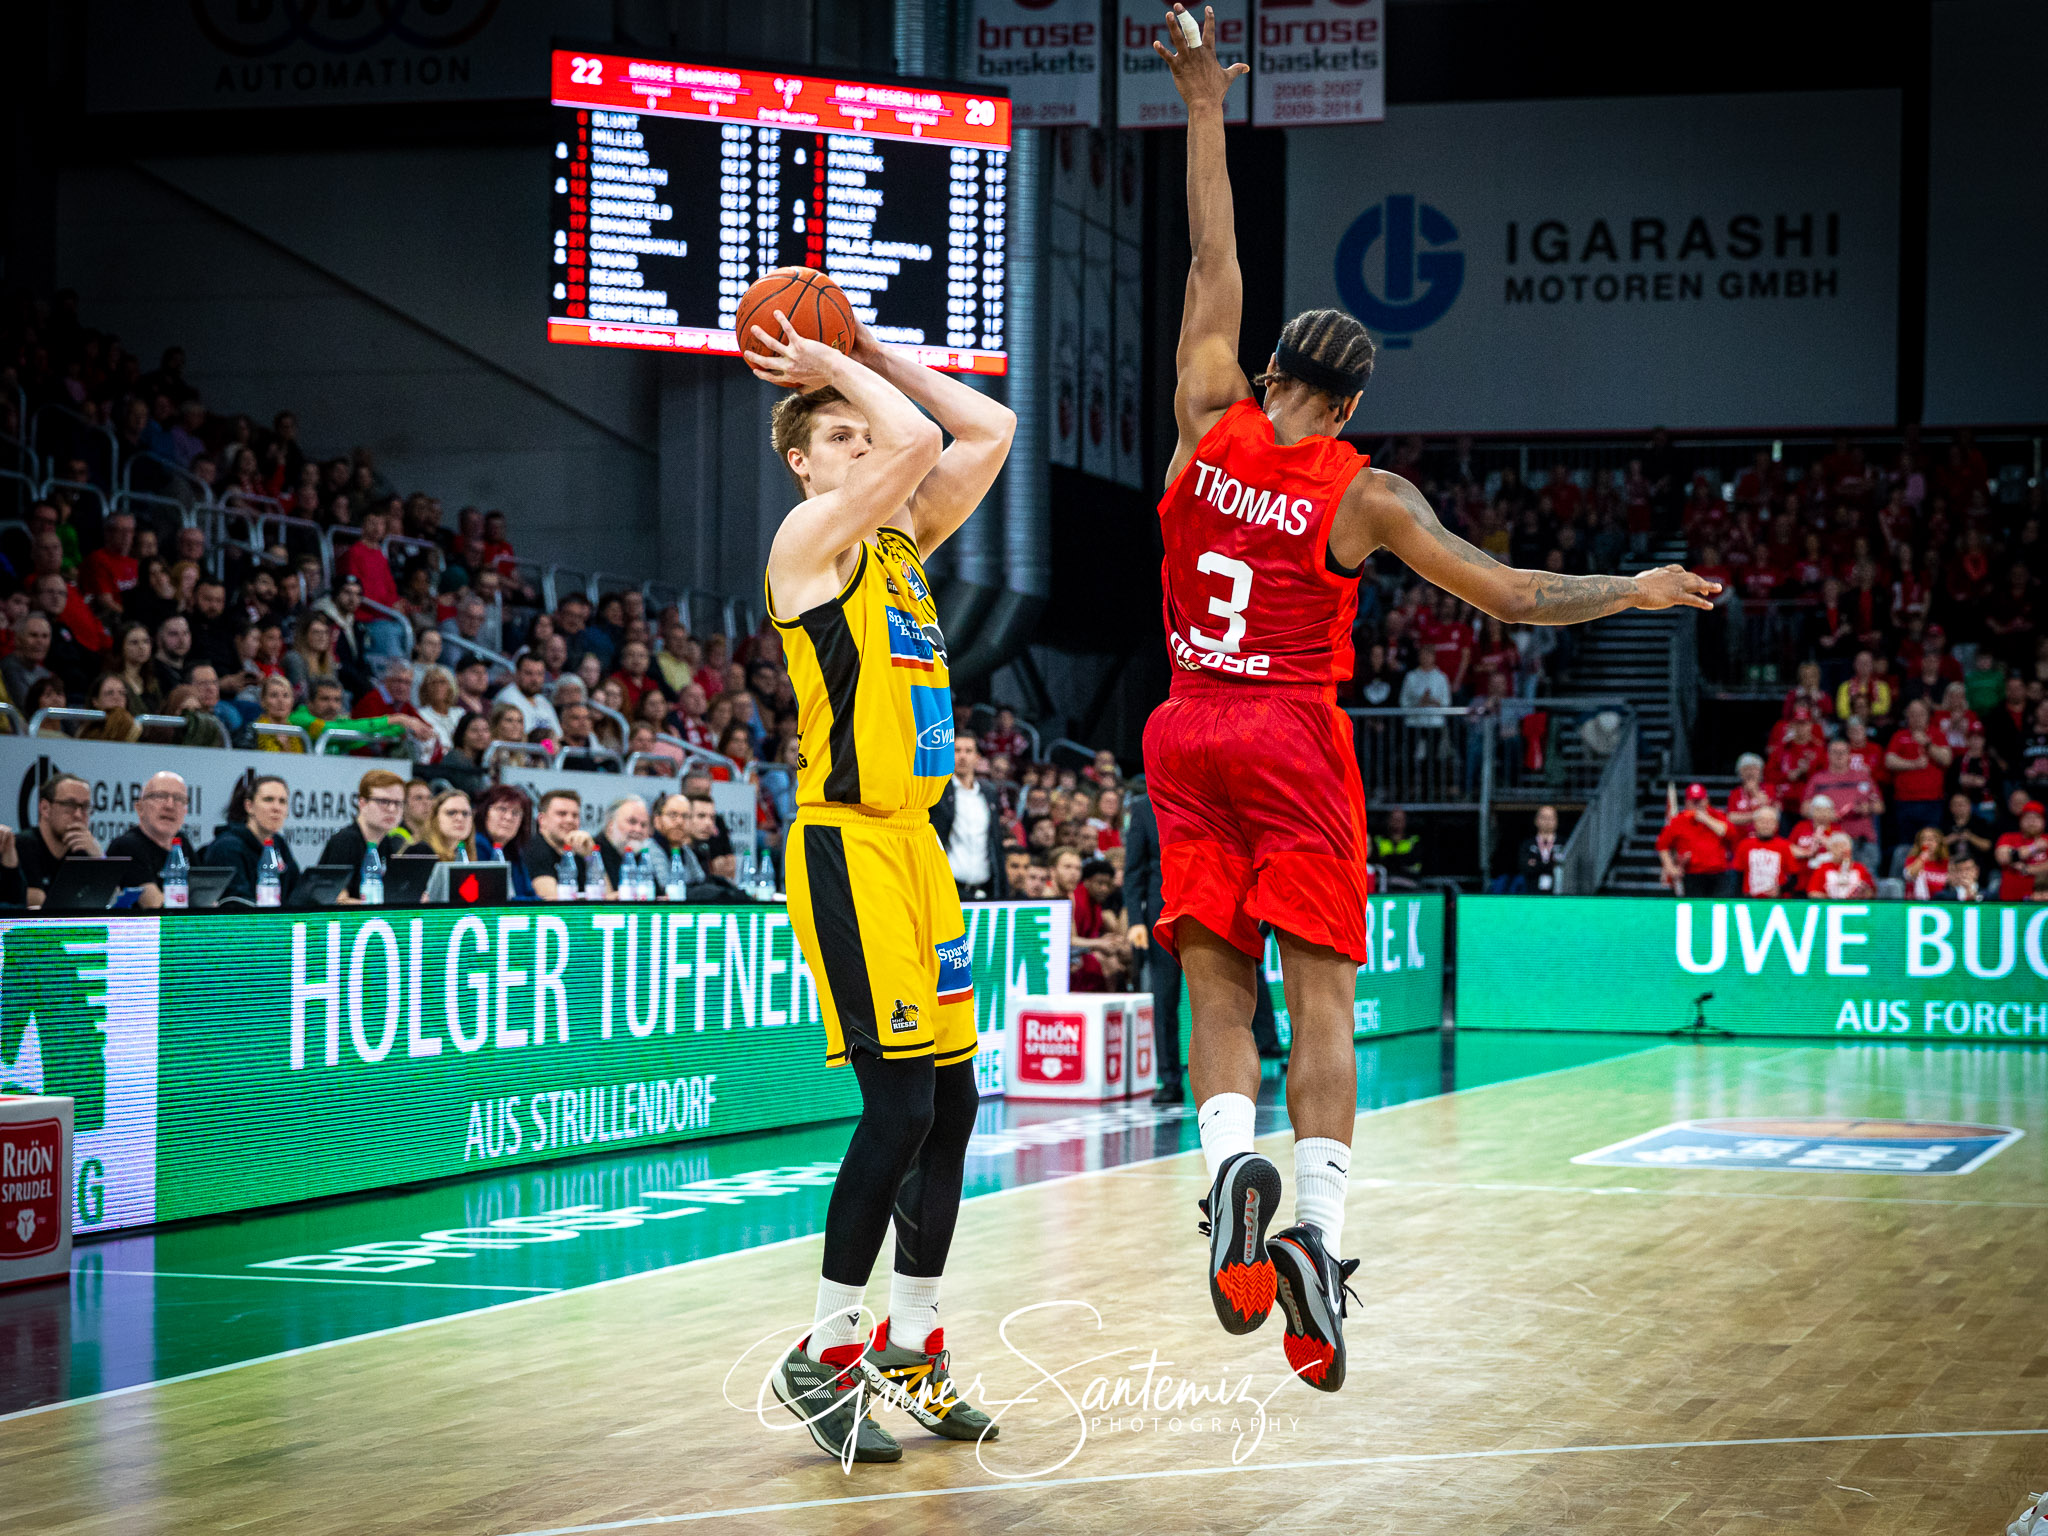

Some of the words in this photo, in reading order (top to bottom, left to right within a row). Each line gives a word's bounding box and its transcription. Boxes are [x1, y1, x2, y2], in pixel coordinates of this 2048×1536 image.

[978, 18, 1095, 48] brose
[1125, 16, 1242, 47] bre
[1259, 14, 1378, 46] brose
[214, 57, 472, 91] AUTOMATION
[571, 56, 603, 86] 22
[977, 51, 1095, 76] baskets
[1259, 47, 1378, 74] baskets
[965, 99, 996, 126] 20
[1506, 213, 1840, 265] IGARASHI
[1507, 273, 1702, 304] MOTOREN
[1718, 269, 1839, 300] GMBH
[1193, 459, 1314, 536] THOMAS
[1190, 550, 1254, 653] 3
[1675, 902, 1870, 977] UWE
[289, 914, 571, 1071] HOLGER
[592, 912, 819, 1040] TUFFNER
[1025, 1018, 1080, 1042] RHÖN
[1834, 999, 1912, 1034] AUS
[1923, 1000, 2048, 1036] FORCH
[463, 1096, 523, 1163] AUS
[530, 1074, 718, 1152] STRULLENDORF
[3, 1139, 53, 1178] RHÖN
[2, 1178, 53, 1203] SPRUDEL
[244, 1203, 707, 1273] BROSE
